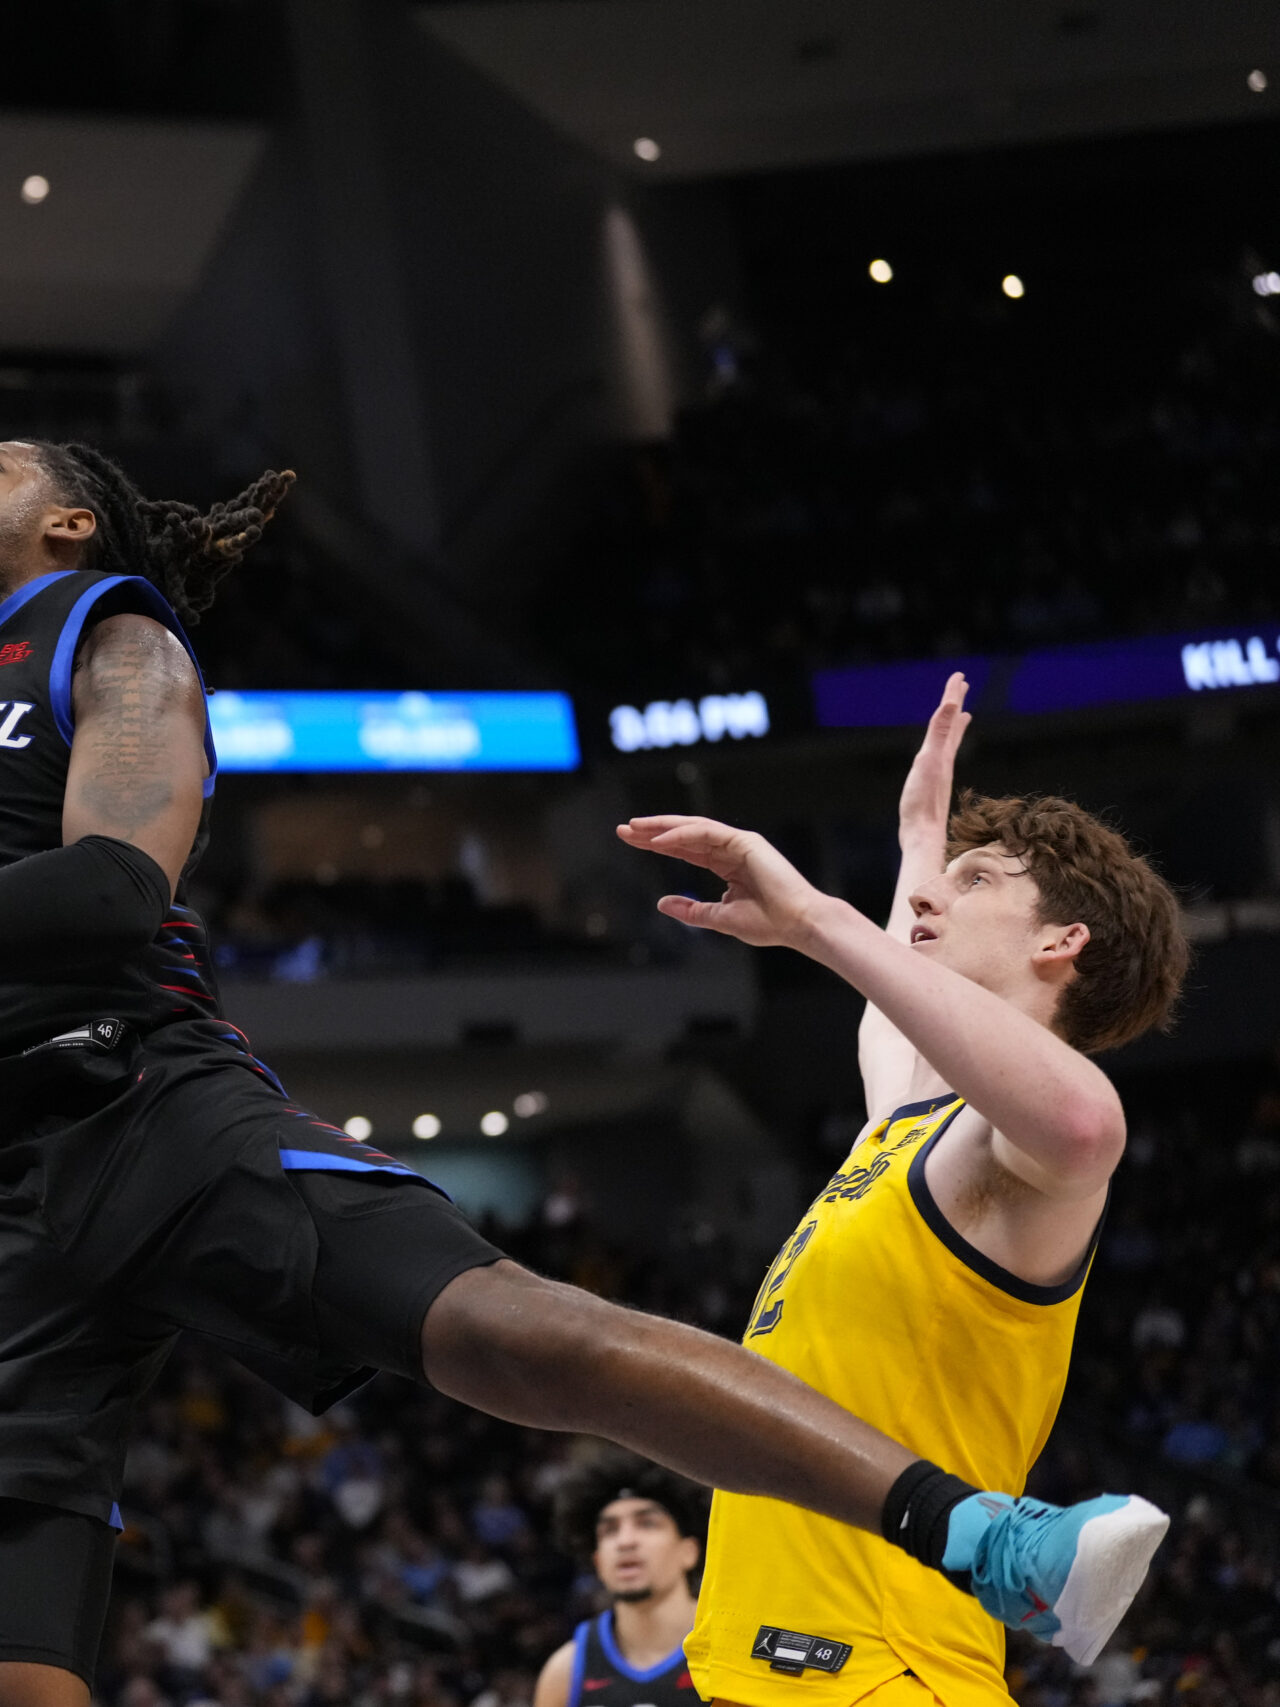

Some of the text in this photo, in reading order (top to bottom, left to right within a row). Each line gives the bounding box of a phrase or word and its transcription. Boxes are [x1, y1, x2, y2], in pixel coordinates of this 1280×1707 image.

[1181, 634, 1280, 692] KILL
[97, 1023, 113, 1039] 46
[814, 1647, 832, 1661] 48
